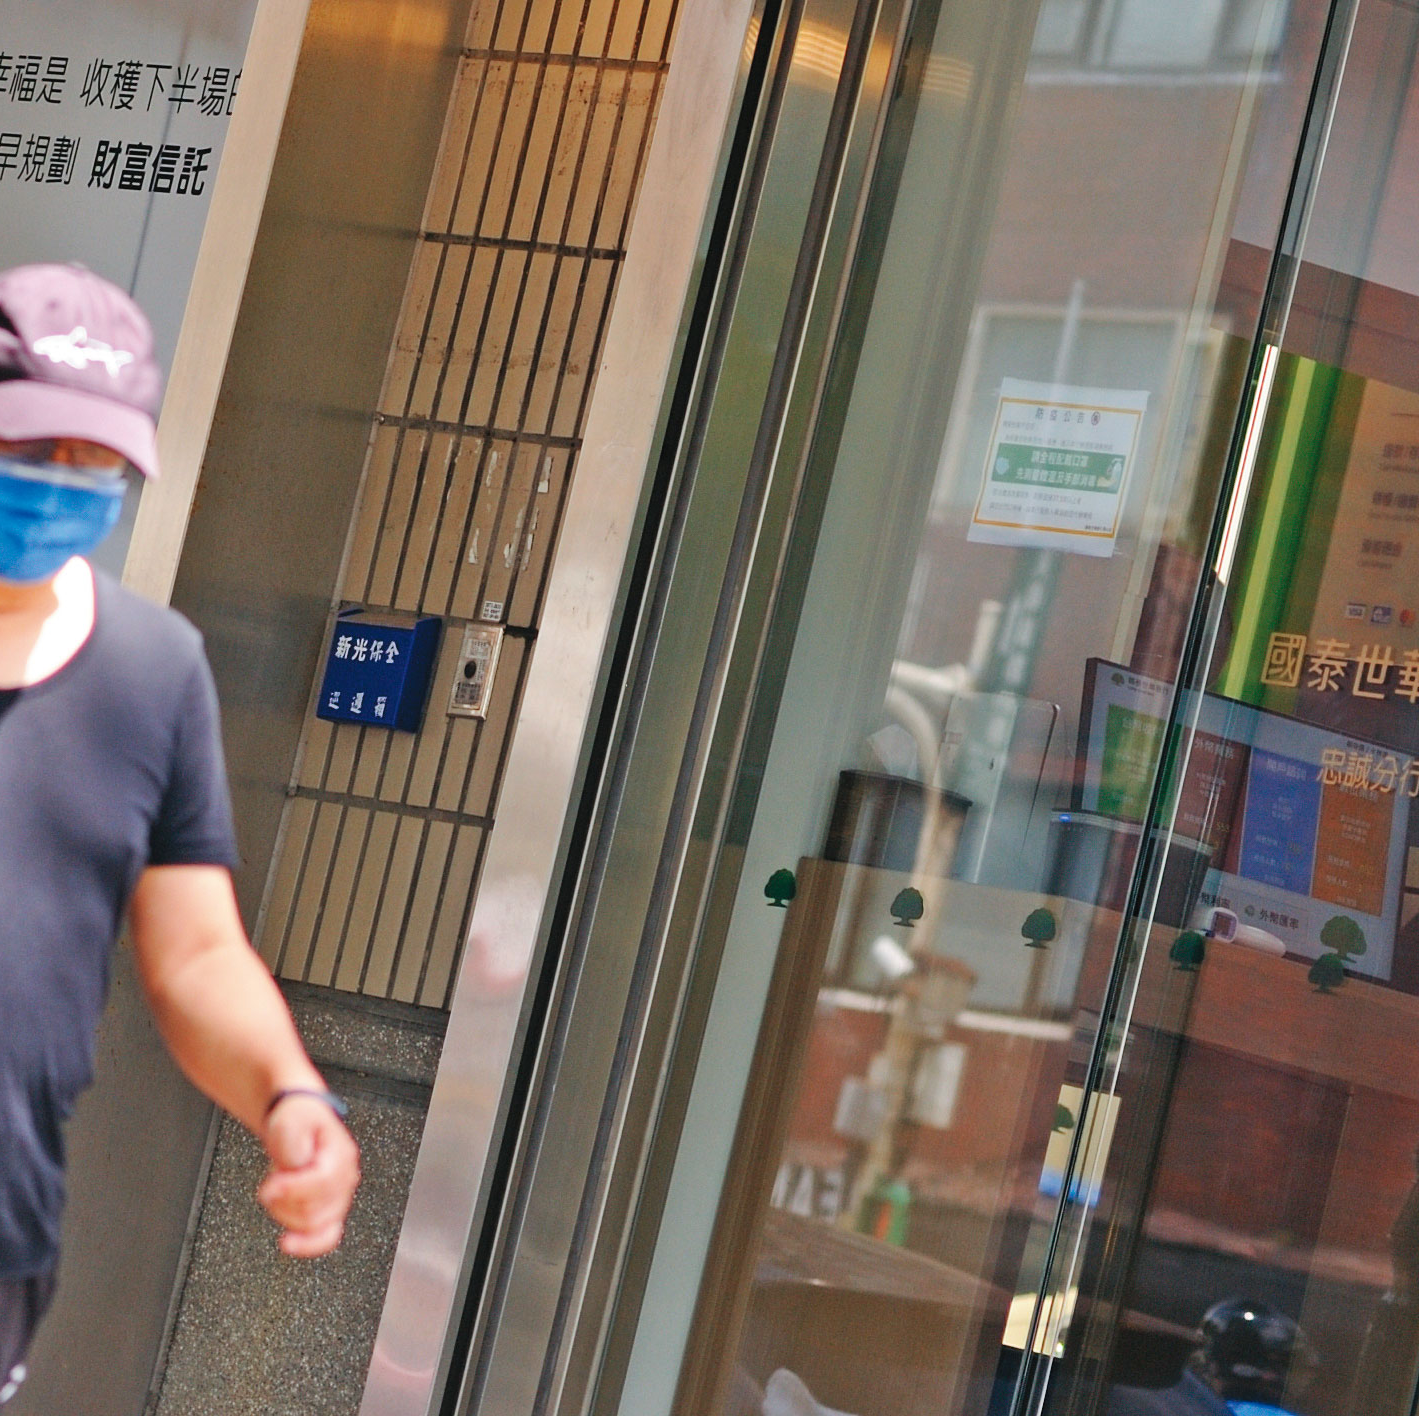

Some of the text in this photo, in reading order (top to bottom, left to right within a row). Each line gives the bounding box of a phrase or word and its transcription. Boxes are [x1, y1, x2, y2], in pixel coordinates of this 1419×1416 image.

[87, 140, 213, 196] 財富信託
[1034, 407, 1085, 424] 防疫公告
[334, 635, 400, 664] 新光保全
